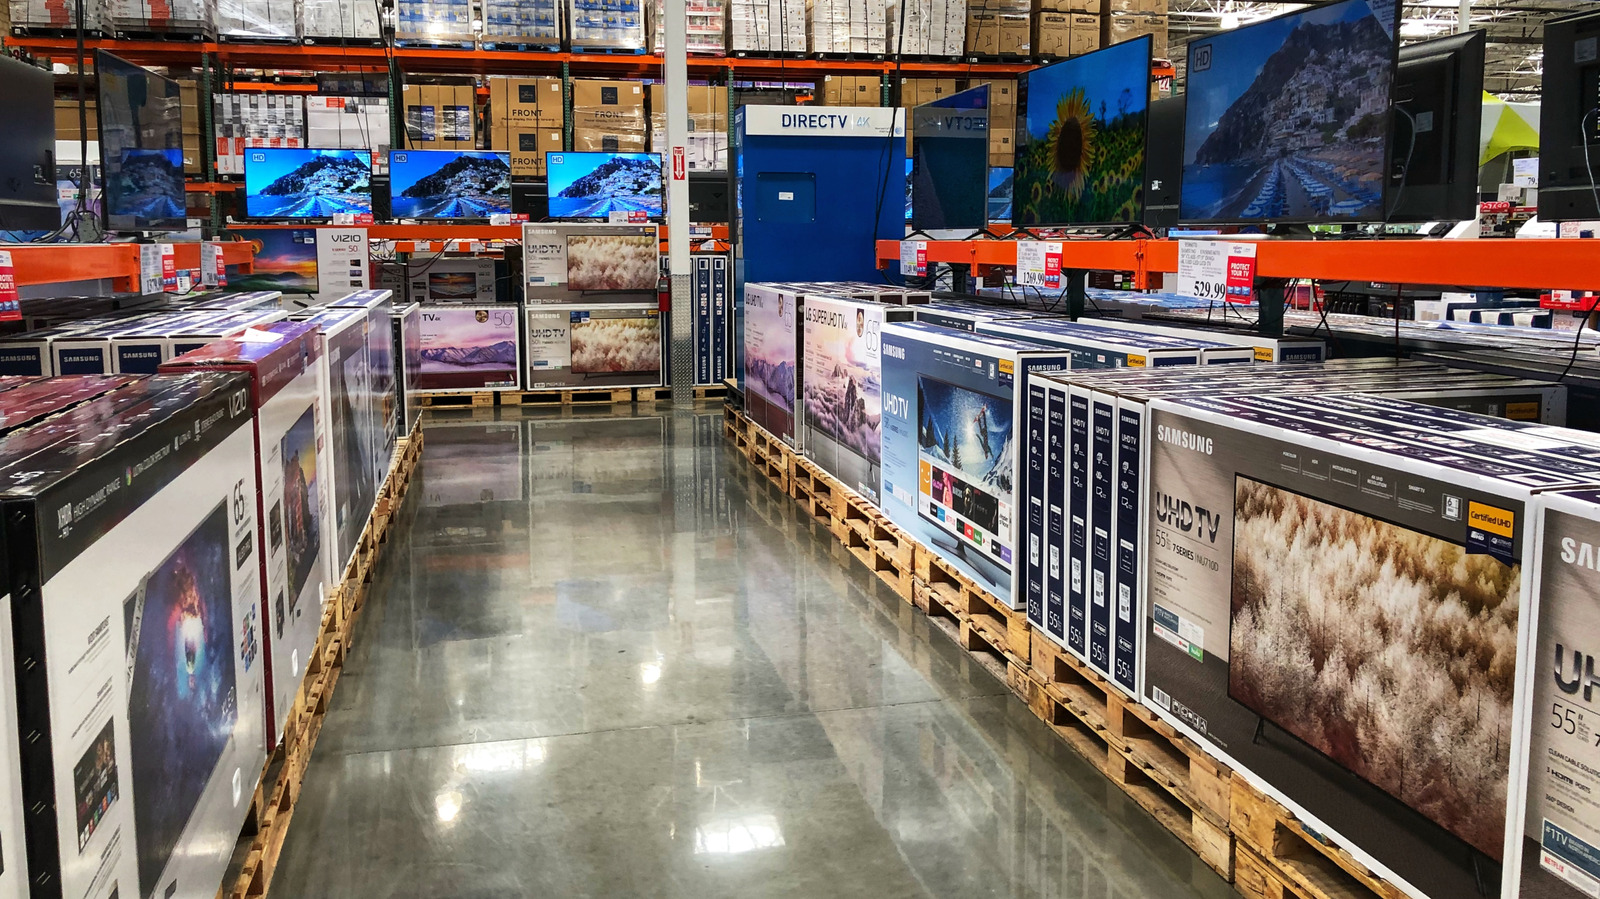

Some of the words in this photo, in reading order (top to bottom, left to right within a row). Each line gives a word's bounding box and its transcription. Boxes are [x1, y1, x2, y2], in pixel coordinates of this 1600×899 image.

[1196, 49, 1210, 68] HD
[512, 109, 543, 117] FRONT
[782, 114, 847, 128] DIRECTV
[856, 116, 871, 127] 4K
[69, 168, 82, 179] 65
[332, 234, 361, 242] VIZIO
[1023, 272, 1044, 286] 1269.99
[1194, 280, 1226, 300] 529.99
[422, 314, 435, 322] TV
[806, 307, 812, 321] LG
[813, 308, 826, 324] SUPER
[882, 343, 905, 360] SAMSUNG
[1028, 364, 1060, 372] SAMSUNG
[1031, 390, 1044, 398] SAMSUNG
[1050, 394, 1064, 403] SAMSUNG
[229, 388, 246, 419] VIZIO
[1072, 400, 1086, 410] SAMSUNG
[1095, 408, 1110, 418] SAMSUNG
[1121, 415, 1138, 426] SAMSUNG
[1157, 424, 1214, 456] SAMSUNG
[1470, 510, 1496, 525] Certified
[1497, 518, 1511, 528] UHD
[1548, 748, 1564, 760] CLEAN
[1564, 756, 1580, 769] CABLE
[1575, 782, 1591, 794] PORTS
[1556, 800, 1574, 814] DESIGN
[1544, 856, 1564, 873] NETFLIX
